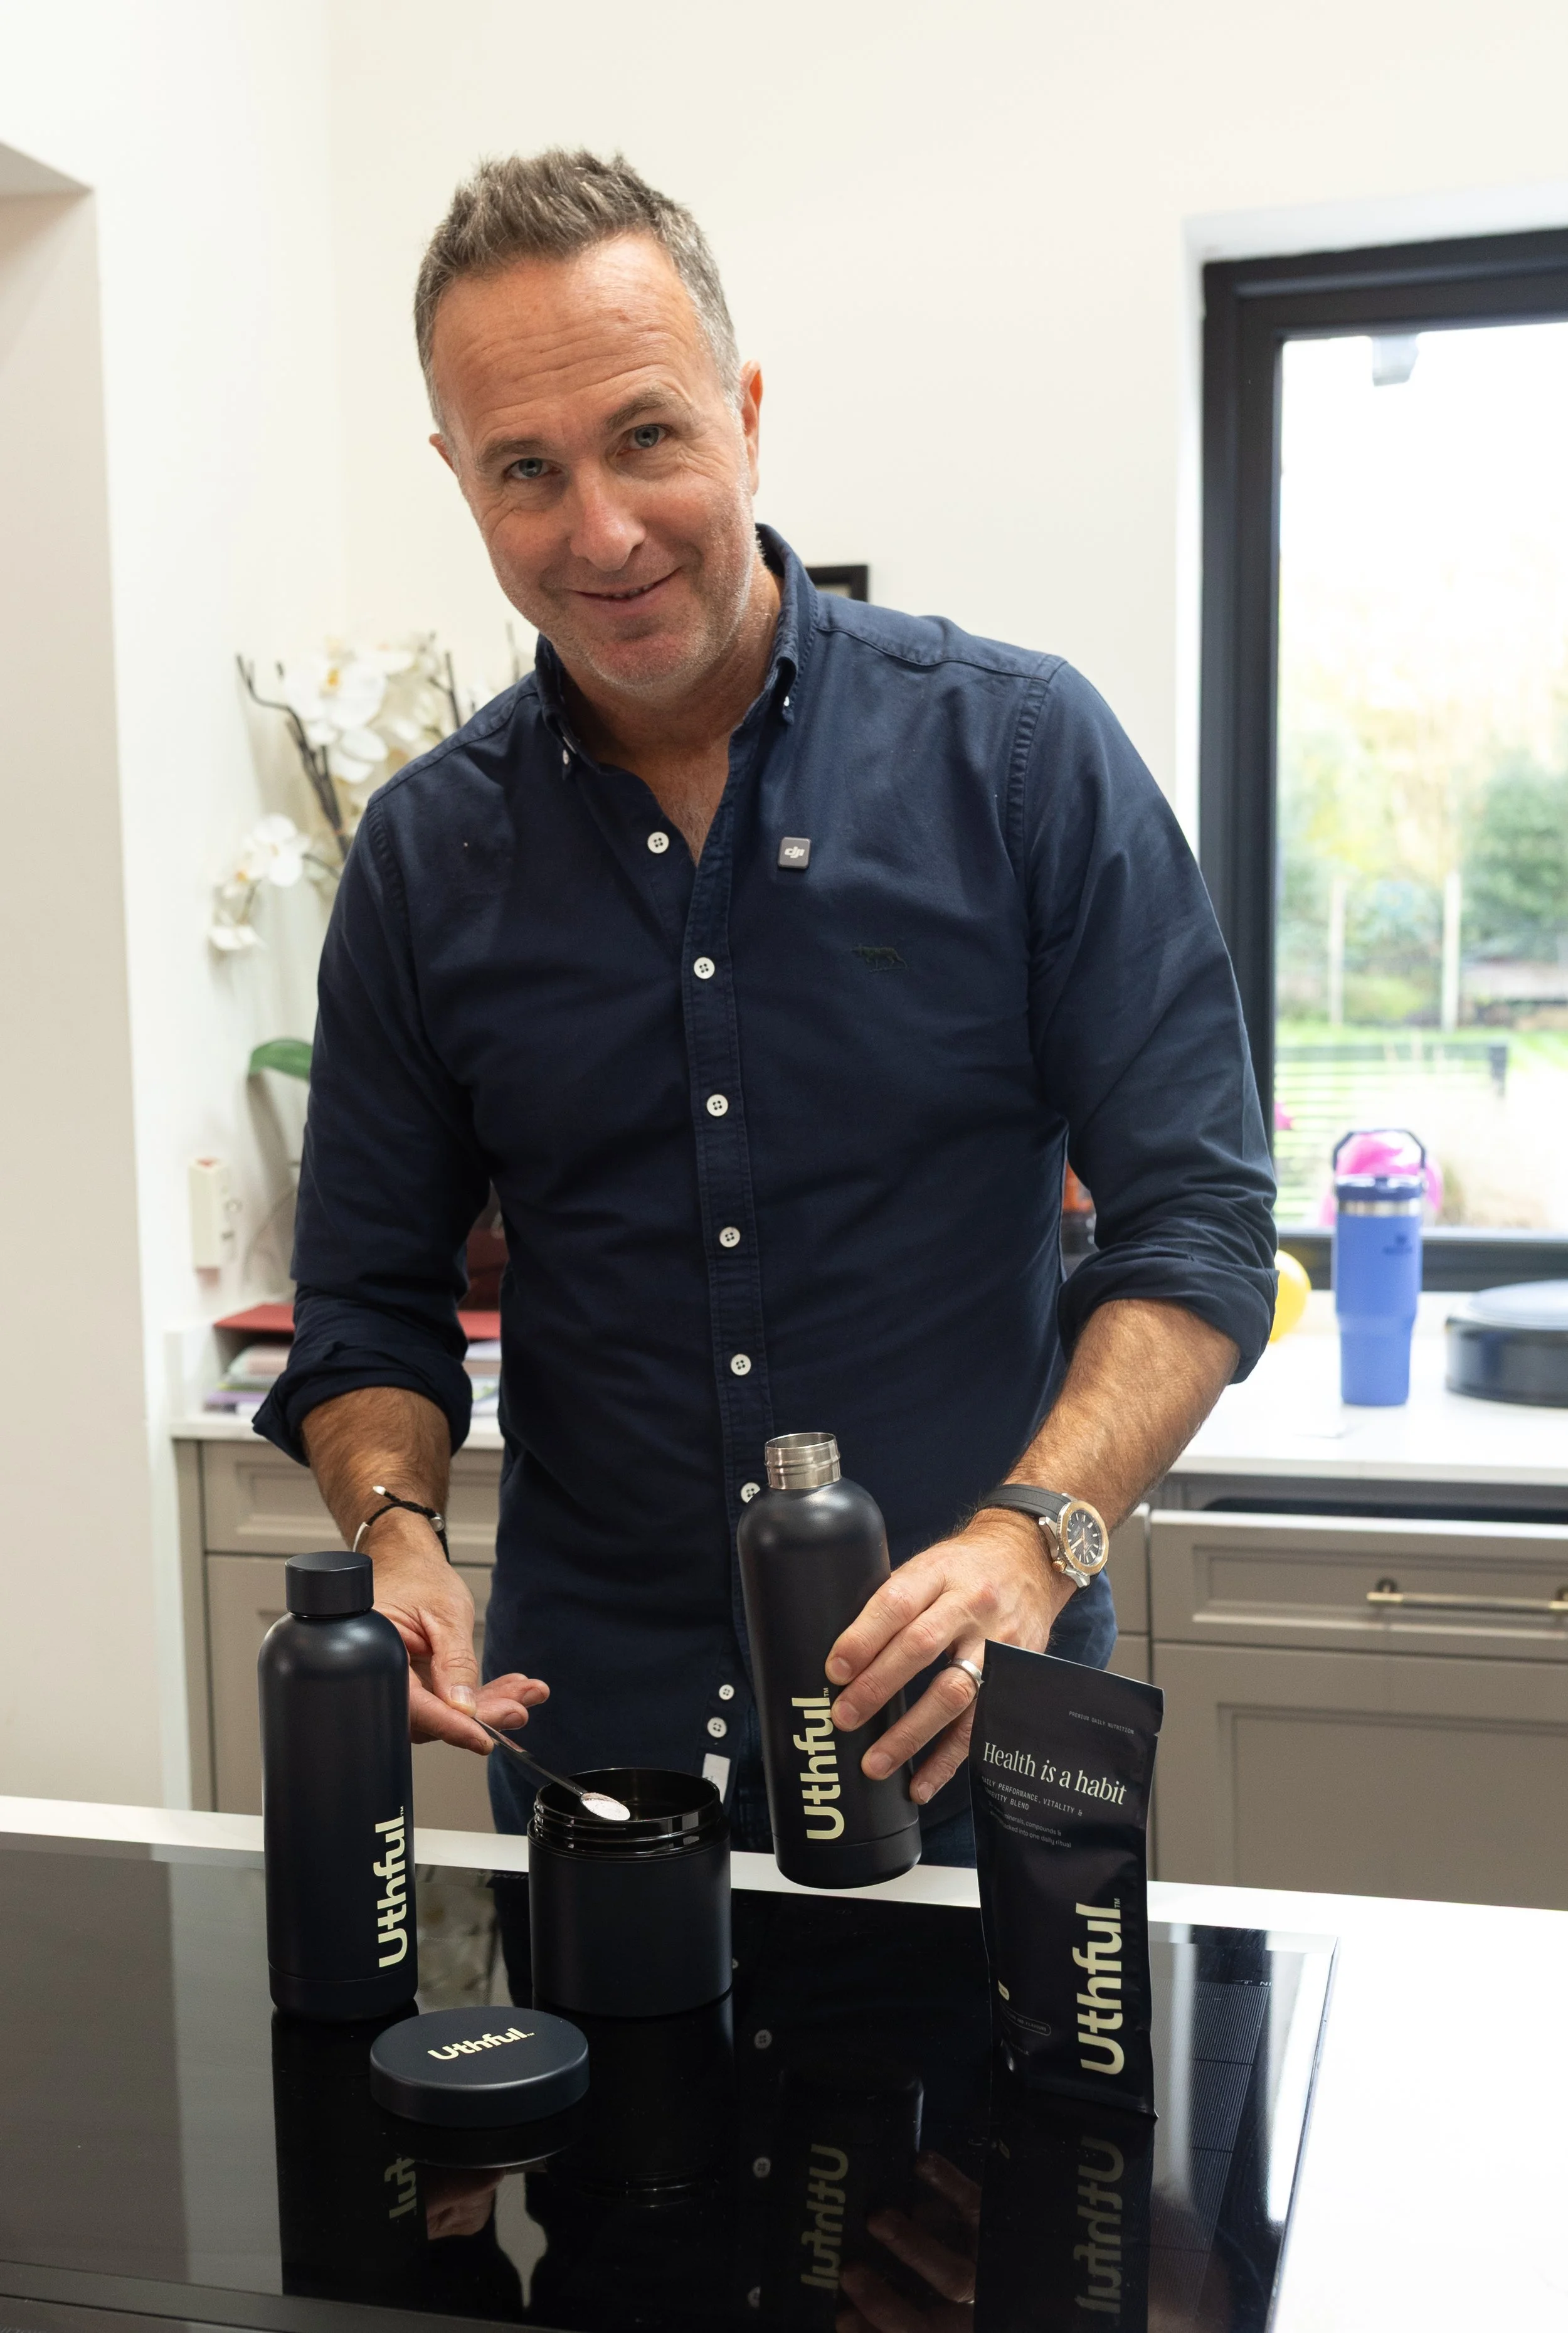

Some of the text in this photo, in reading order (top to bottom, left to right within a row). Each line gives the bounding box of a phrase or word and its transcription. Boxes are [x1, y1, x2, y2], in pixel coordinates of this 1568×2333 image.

[1069, 1711, 1135, 1734] PREMIUM DAILY NUTRITION
[983, 1741, 1127, 1805] Health is a habit
[985, 1788, 1008, 1803] EVITY
[1010, 1798, 1029, 1811] BLEND
[999, 1783, 1041, 1804] PERFORMANCE,
[1043, 1798, 1075, 1814] VITALITY
[1019, 1828, 1029, 1837] into
[1029, 1832, 1040, 1841] one
[1041, 1834, 1055, 1846] daily
[1056, 1839, 1072, 1849] ritual
[1025, 1820, 1057, 1835] compounds
